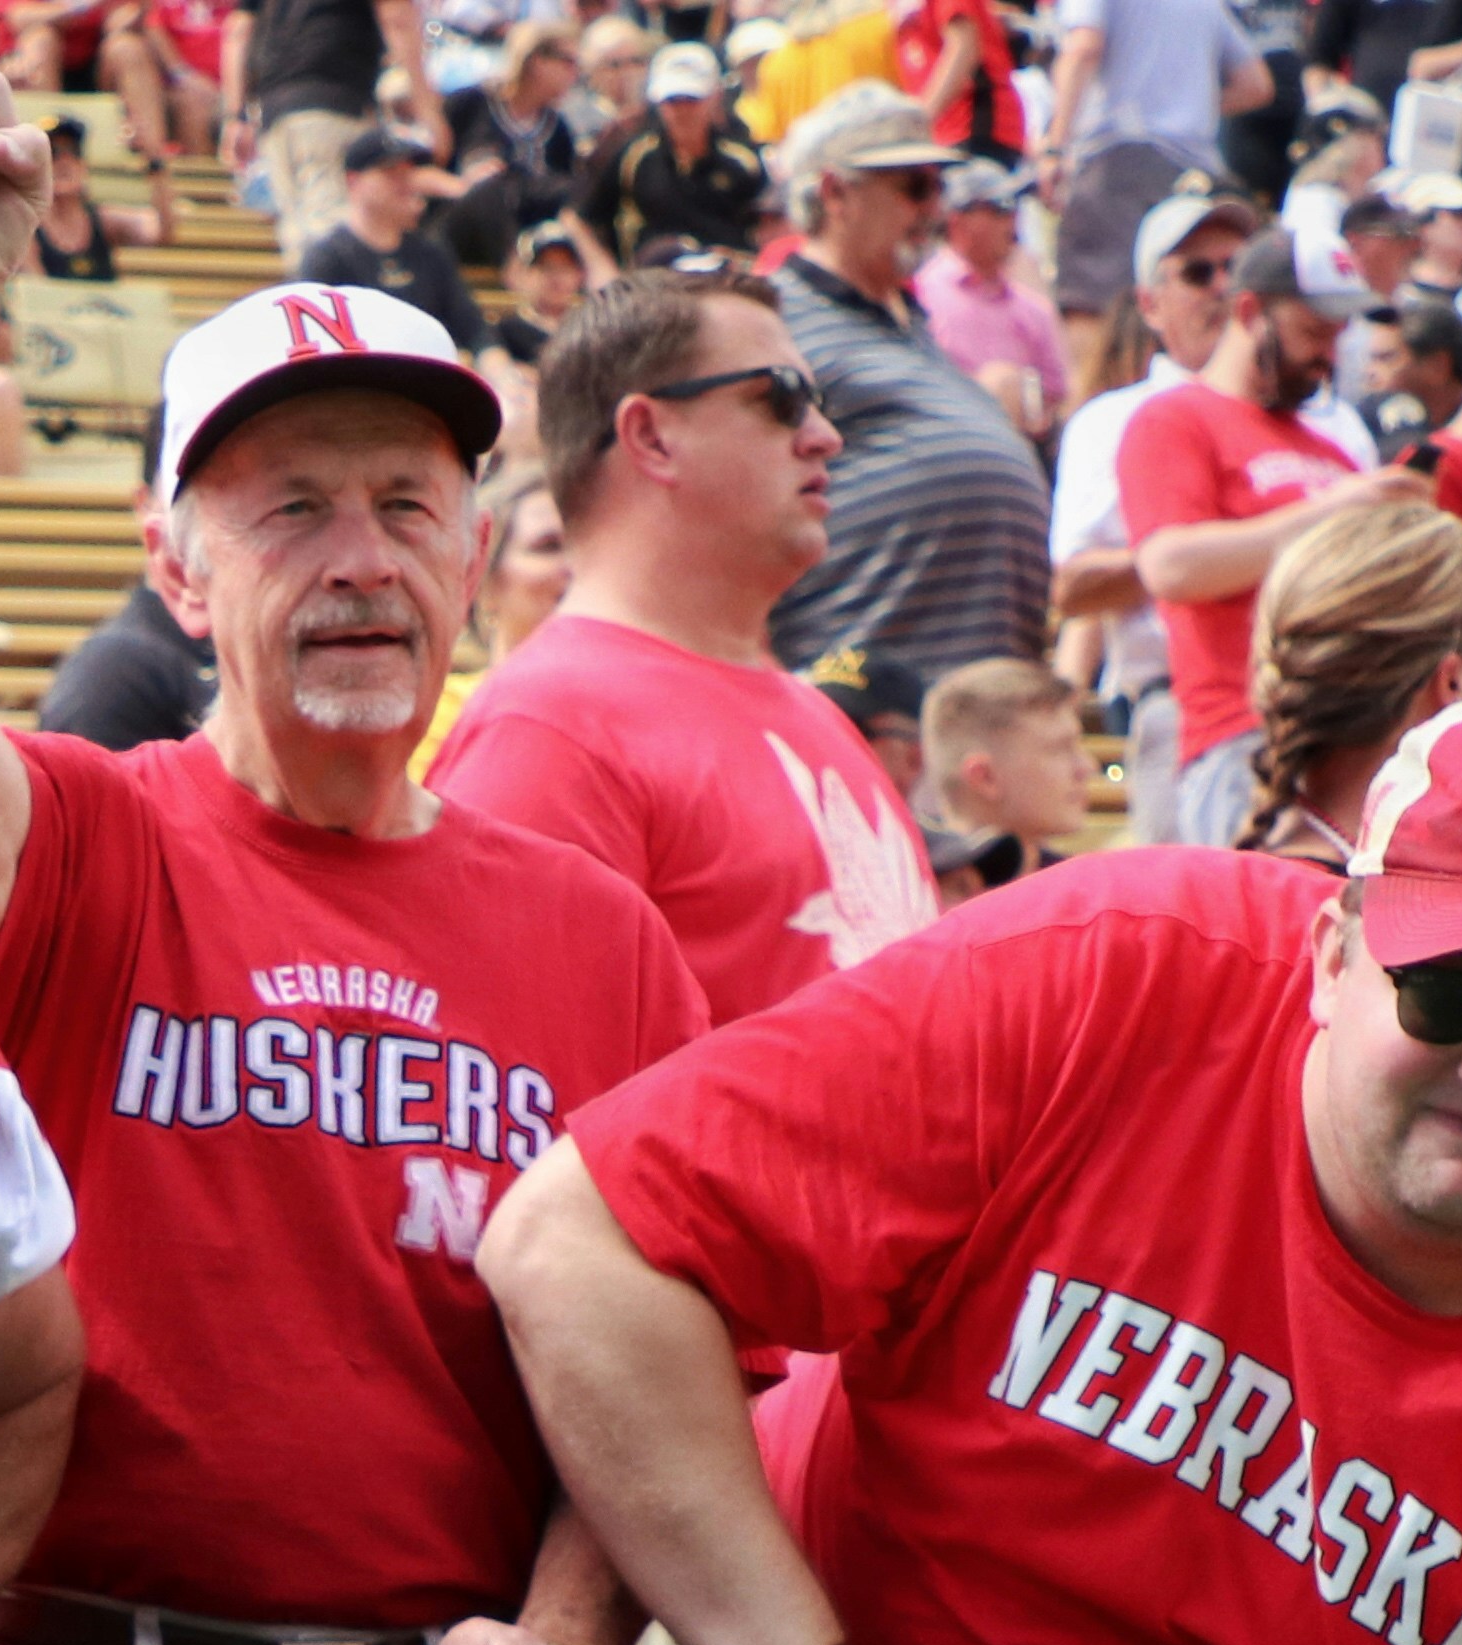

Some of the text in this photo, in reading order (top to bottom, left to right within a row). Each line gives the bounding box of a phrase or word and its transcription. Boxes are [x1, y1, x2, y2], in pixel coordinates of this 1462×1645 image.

[273, 290, 368, 361] N
[250, 963, 442, 1031] NEBRASKA
[112, 1002, 557, 1175] HUSKERS
[395, 1155, 490, 1261] N
